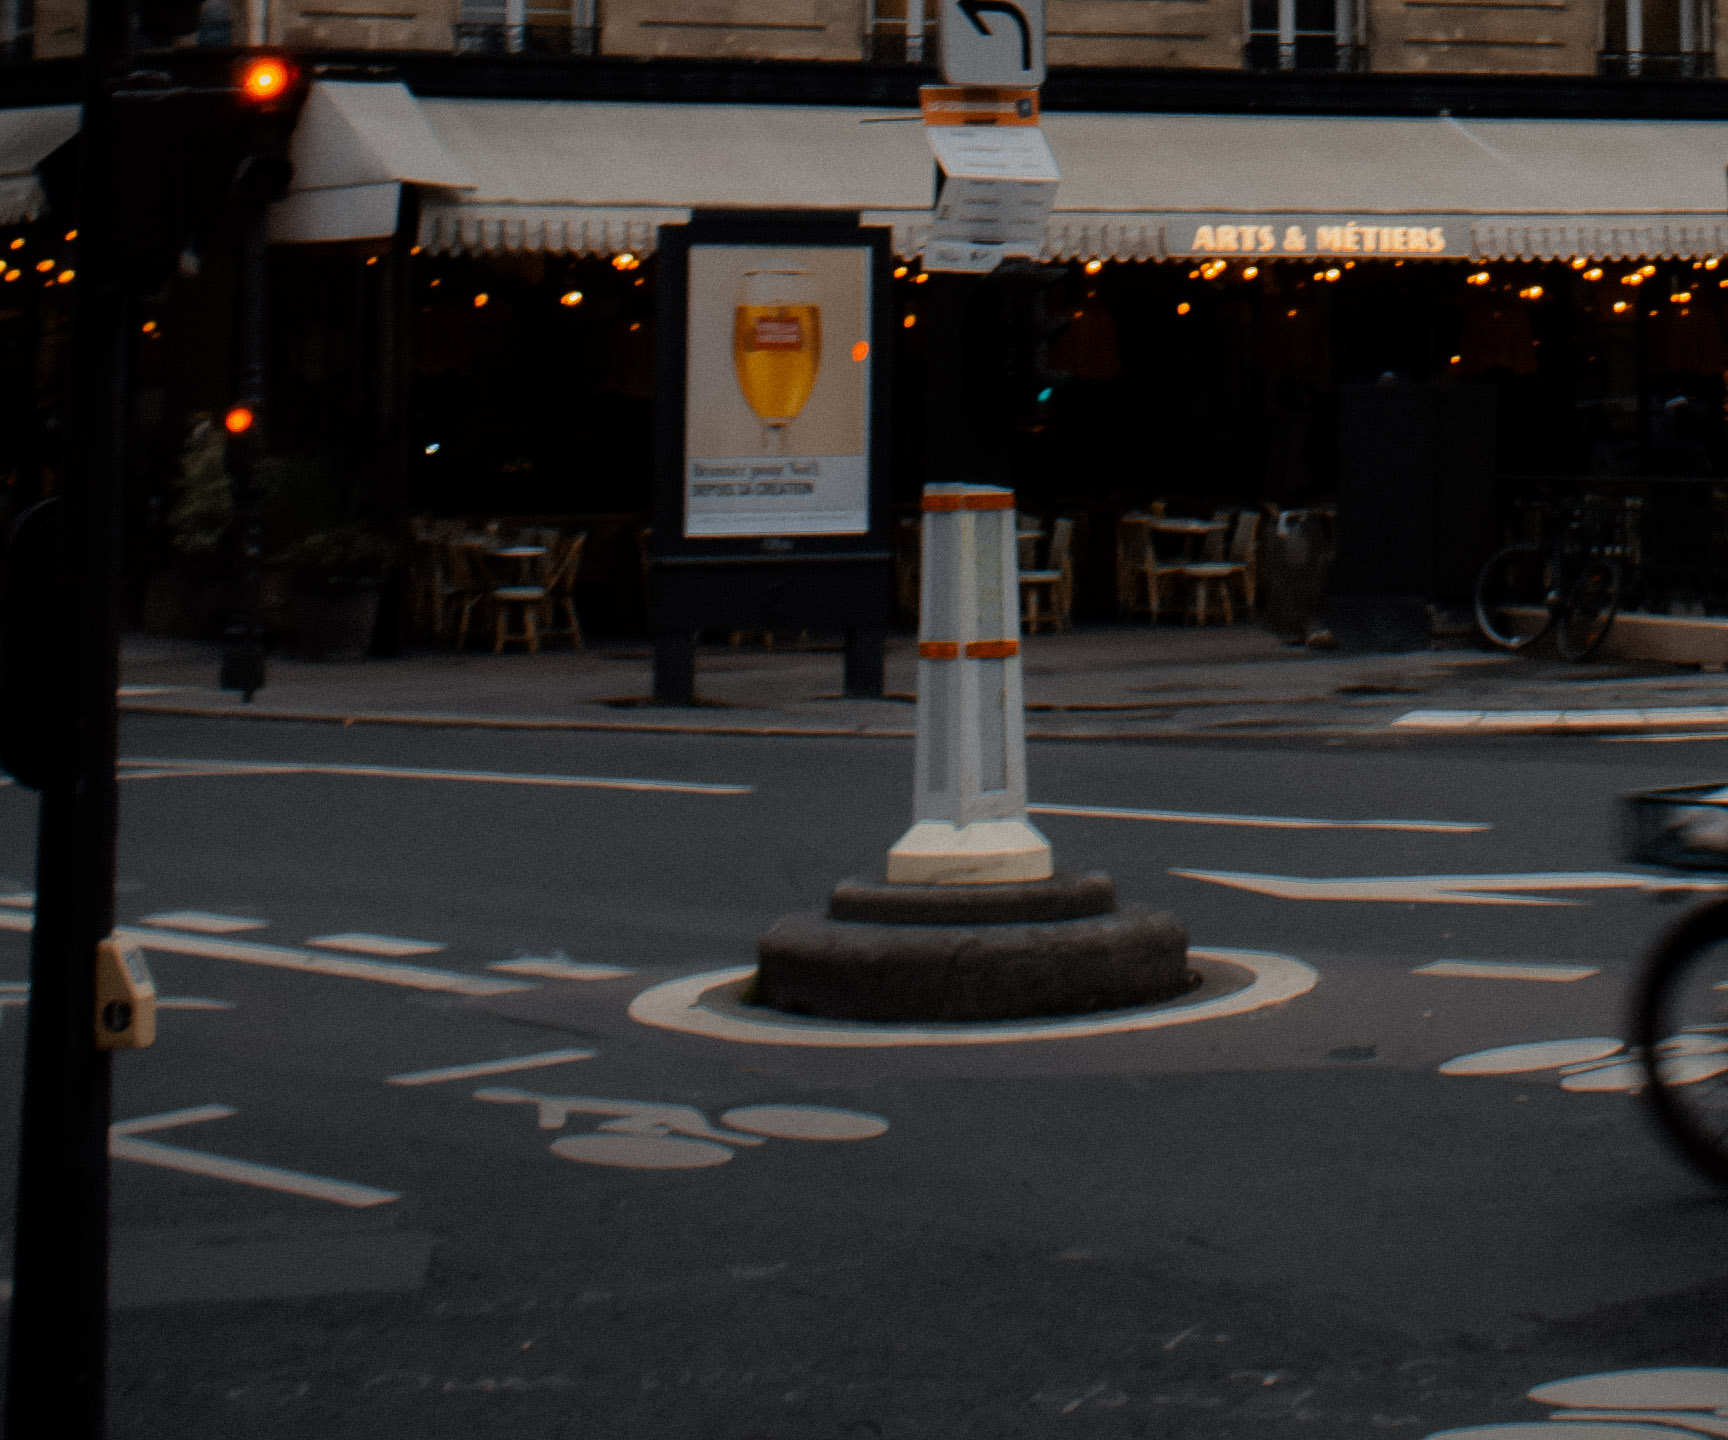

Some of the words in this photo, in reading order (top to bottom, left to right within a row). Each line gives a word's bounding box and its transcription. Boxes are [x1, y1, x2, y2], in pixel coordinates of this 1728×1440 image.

[1191, 224, 1276, 252] ARTS
[1282, 224, 1307, 252] &
[1315, 220, 1446, 253] MÉTIERS
